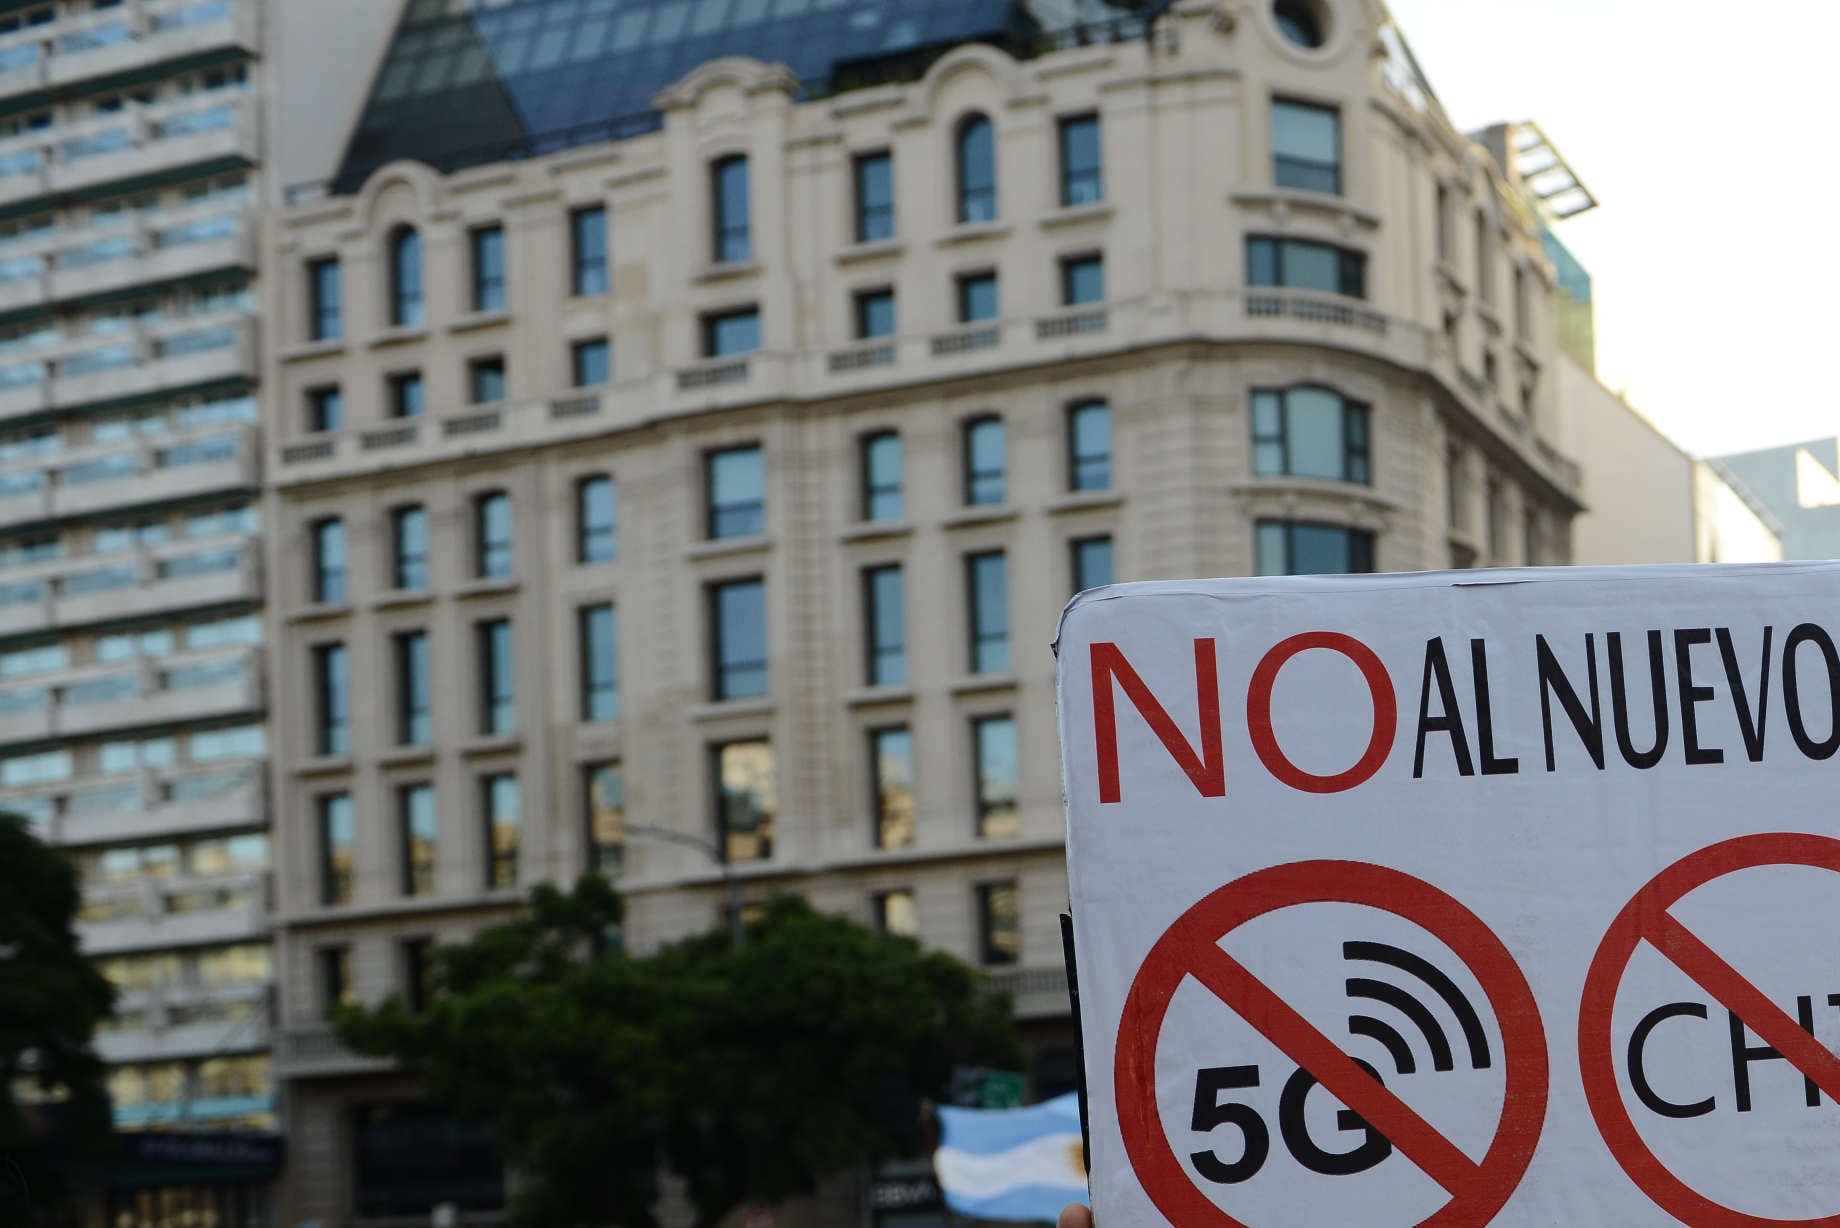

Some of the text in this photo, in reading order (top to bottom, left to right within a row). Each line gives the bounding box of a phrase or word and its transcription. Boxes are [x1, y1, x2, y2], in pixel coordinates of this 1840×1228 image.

[1090, 632, 1396, 803] NO
[1413, 636, 1518, 778] AL
[1190, 1057, 1392, 1184] 5G
